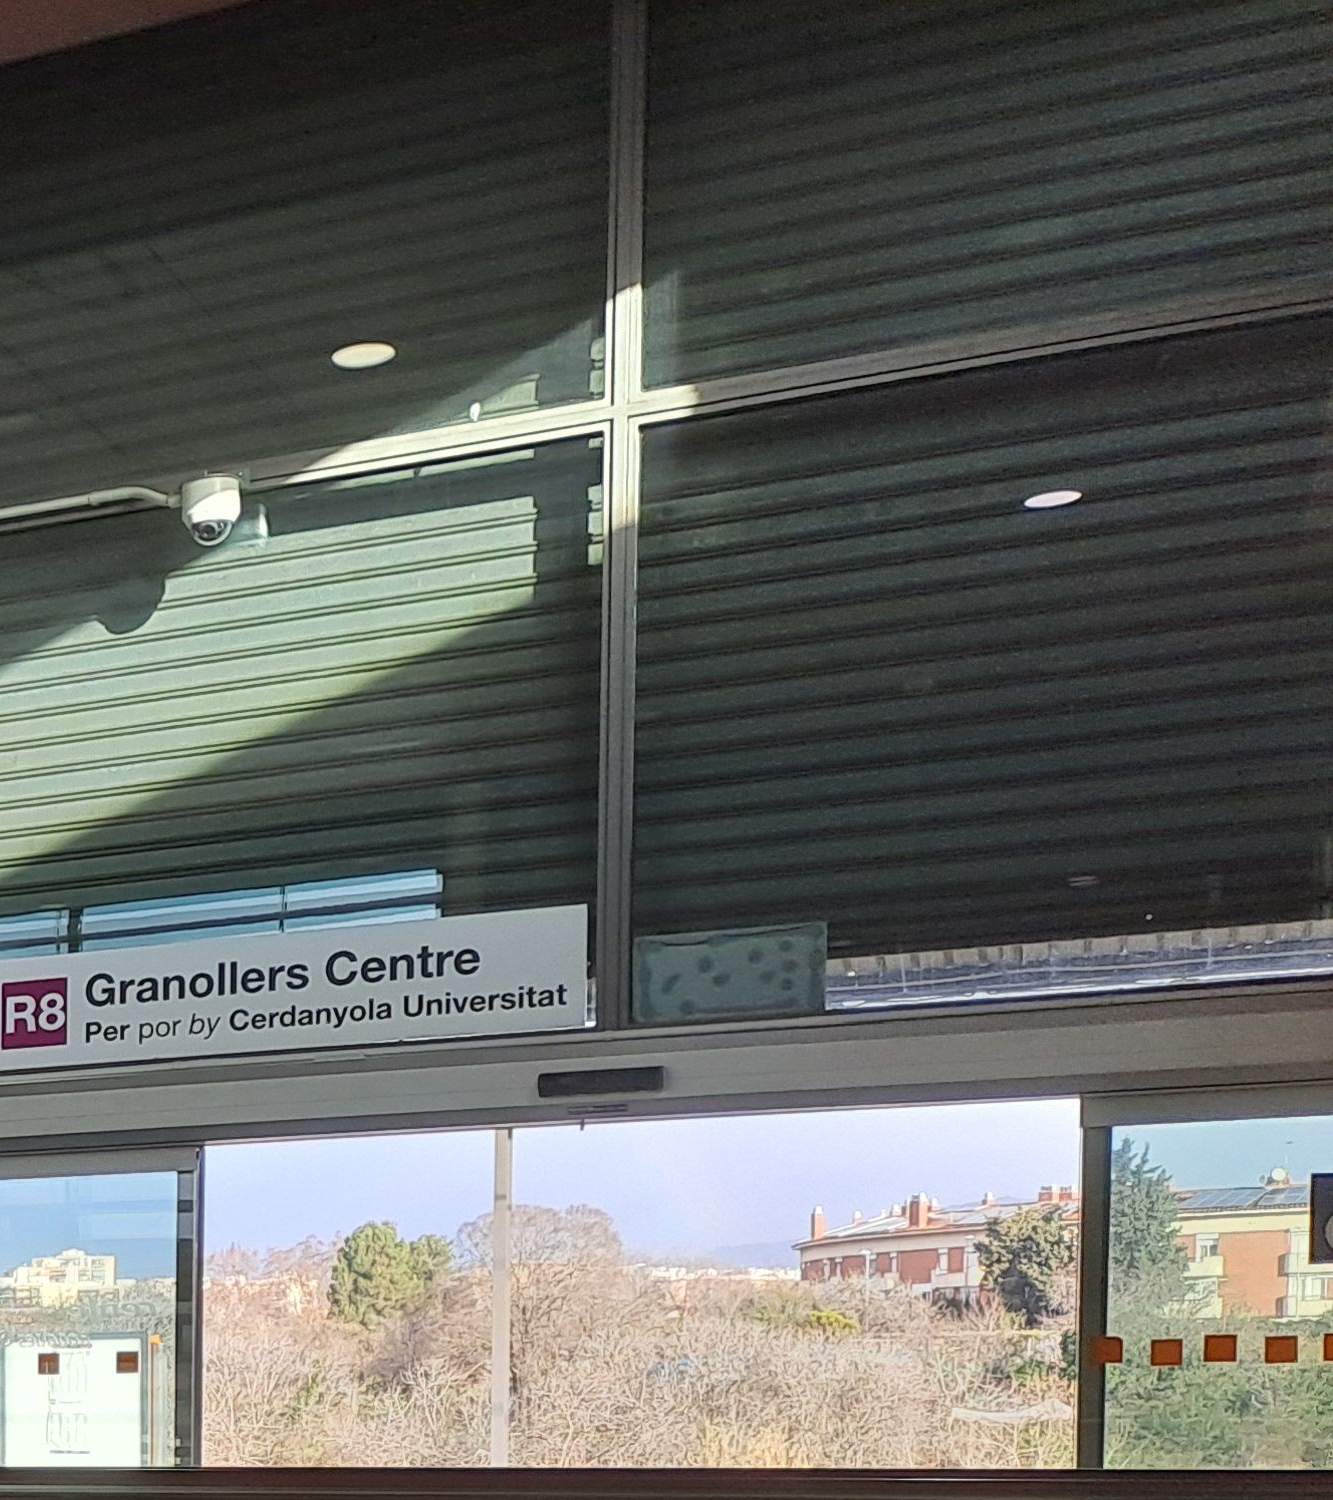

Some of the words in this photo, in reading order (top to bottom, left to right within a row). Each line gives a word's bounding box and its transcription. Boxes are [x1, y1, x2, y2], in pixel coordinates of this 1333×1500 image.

[85, 961, 310, 1007] Granollers
[325, 945, 481, 987] Centre
[5, 992, 66, 1034] R8
[85, 1021, 131, 1043] Per
[139, 1019, 181, 1044] por
[188, 1012, 222, 1040] by
[229, 998, 393, 1031] Cerdanyola
[402, 984, 568, 1018] Universitat
